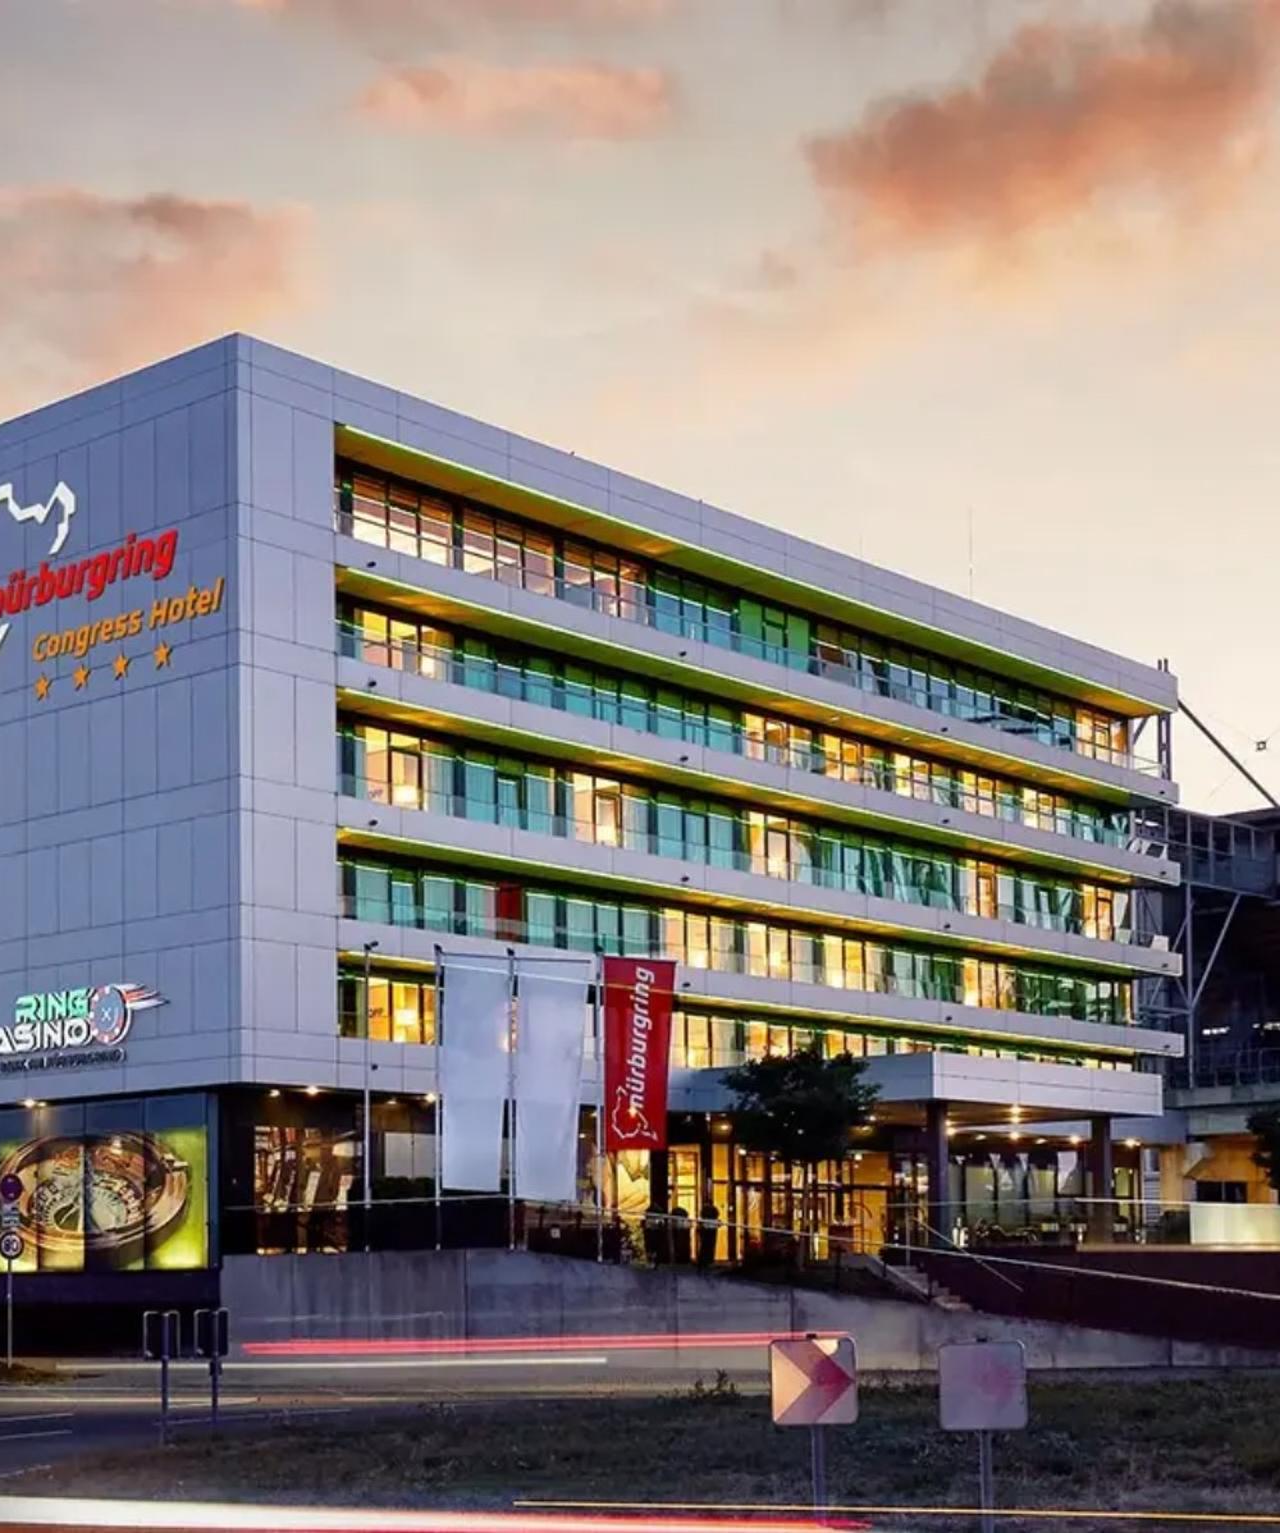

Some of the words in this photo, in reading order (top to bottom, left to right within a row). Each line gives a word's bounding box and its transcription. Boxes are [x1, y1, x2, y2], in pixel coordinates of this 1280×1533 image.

[32, 609, 143, 661] Congress
[149, 577, 225, 630] Hotel
[15, 988, 90, 1022] RING
[626, 966, 655, 1110] nürburgring
